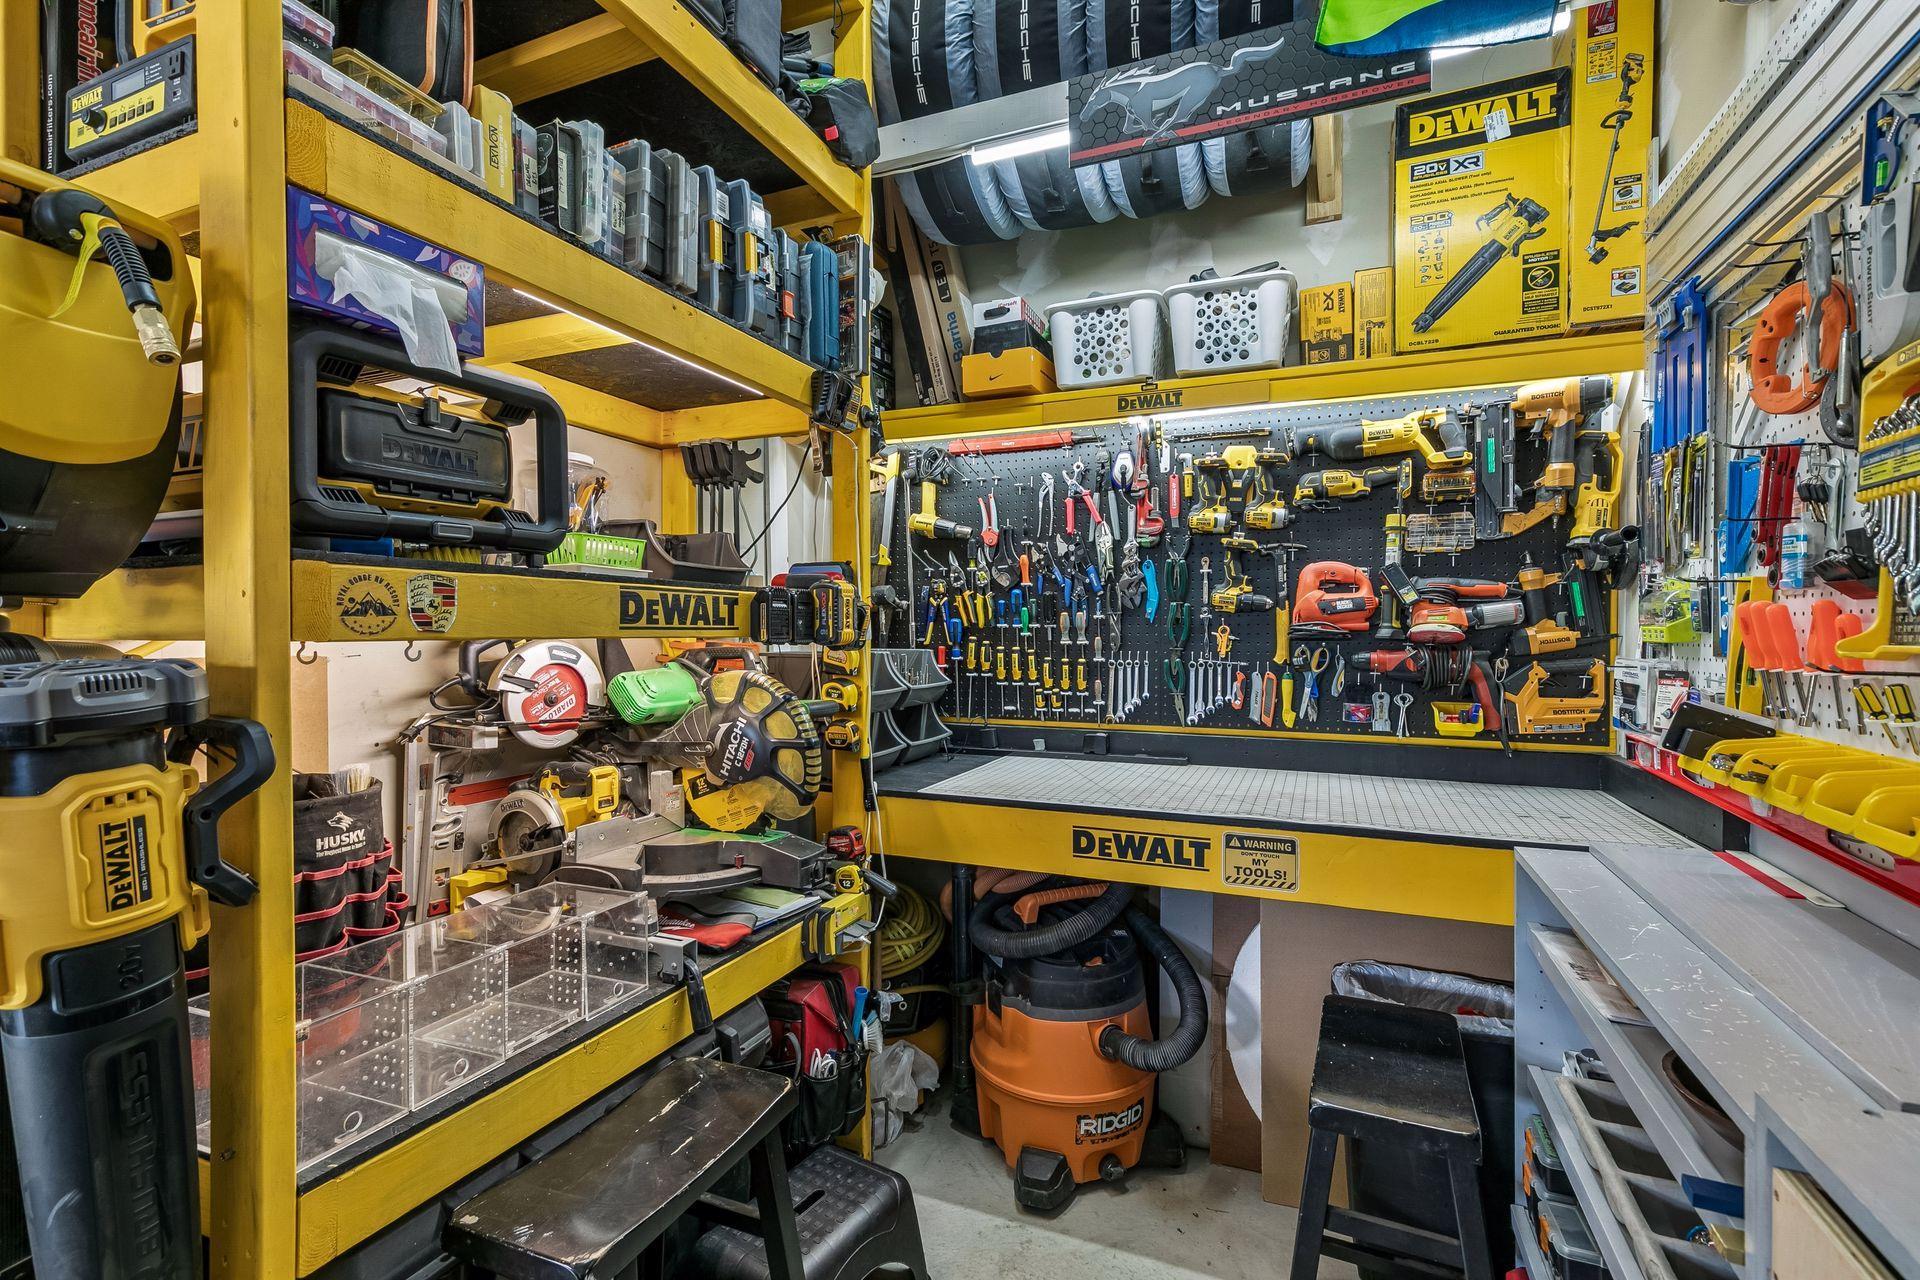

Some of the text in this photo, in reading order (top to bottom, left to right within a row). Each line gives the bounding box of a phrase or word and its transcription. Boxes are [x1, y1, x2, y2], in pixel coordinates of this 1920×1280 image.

[911, 0, 928, 104] PORSCHE
[1020, 0, 1032, 82] RSCHE
[72, 86, 103, 114] DEWALT
[1217, 61, 1416, 116] MUSTANG
[1217, 78, 1416, 127] LEGENDARY HORSEPOWER
[1410, 86, 1558, 144] DEWALT
[489, 124, 499, 170] LEXIVON
[1452, 154, 1481, 172] XR
[934, 262, 951, 301] LED
[1322, 290, 1334, 312] XR
[1118, 392, 1182, 412] DEWALT
[1531, 391, 1564, 400] BOSTITCH
[1368, 428, 1392, 437] DEWALT
[382, 438, 478, 472] DEWALT
[336, 585, 350, 606] ROYAL
[348, 574, 372, 586] GORGE
[384, 582, 400, 608] RESORT
[620, 588, 739, 628] DEWALT
[1540, 637, 1570, 646] BOSTITCH
[546, 697, 575, 719] DIABLO
[720, 717, 748, 777] HITACHI
[501, 800, 524, 812] DEWALT
[1072, 829, 1211, 868] DEWALT
[1243, 838, 1292, 852] WARNING
[102, 822, 134, 912] DEWALT
[1234, 866, 1287, 880] TOOLS!
[1252, 858, 1268, 866] MY
[1080, 1104, 1142, 1135] RIDGID
